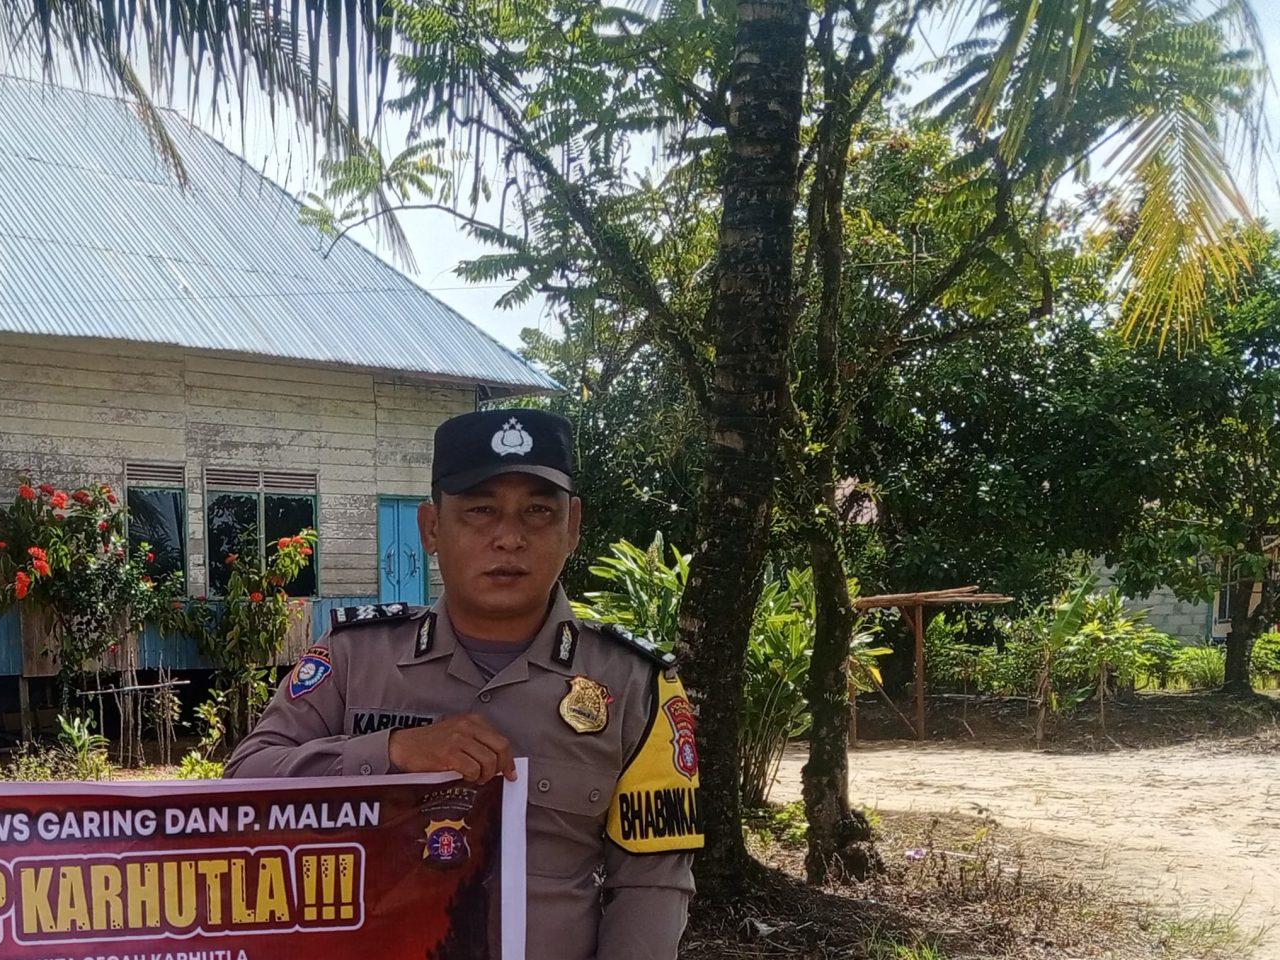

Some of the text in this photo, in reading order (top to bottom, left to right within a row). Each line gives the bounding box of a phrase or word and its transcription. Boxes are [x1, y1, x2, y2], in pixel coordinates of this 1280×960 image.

[37, 809, 157, 840] GARING
[165, 806, 229, 834] DAN
[237, 805, 260, 831] P.
[268, 802, 380, 830] MALAN
[20, 857, 290, 934] KARHUTLA
